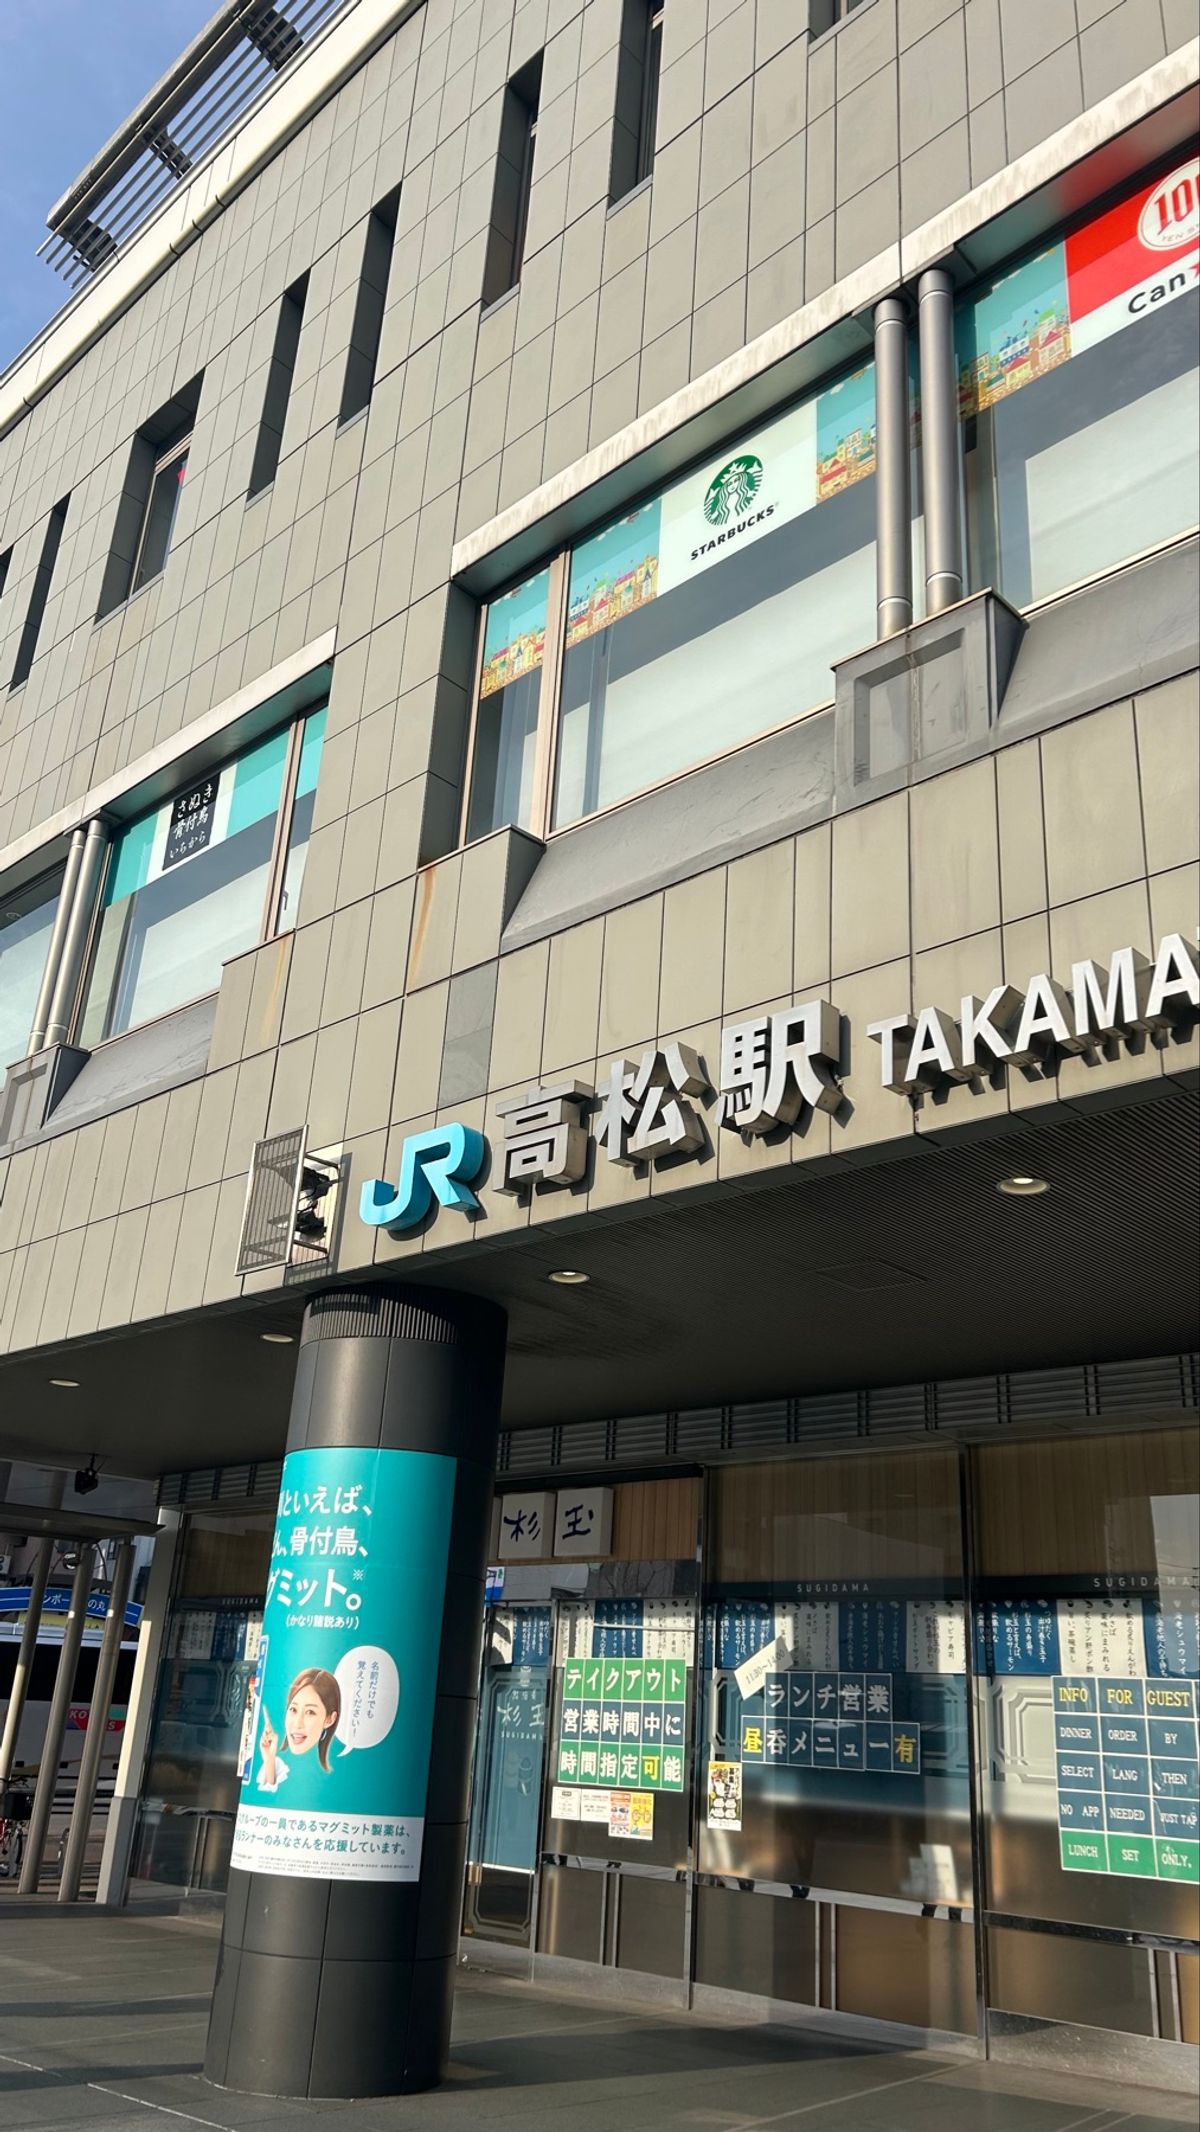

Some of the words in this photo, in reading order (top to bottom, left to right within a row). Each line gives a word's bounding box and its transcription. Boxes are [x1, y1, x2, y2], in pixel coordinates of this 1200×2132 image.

[1128, 271, 1186, 314] Can
[690, 505, 775, 560] STARBUCKS
[177, 783, 213, 818] さぬき
[359, 1122, 482, 1231] JR
[495, 1000, 838, 1194] 高松駅
[867, 926, 1199, 1088] TAKAMA
[503, 1505, 594, 1541] 杉玉
[797, 1583, 869, 1592] SUGIDAMA
[566, 1667, 681, 1692] テイクアウト
[767, 1684, 890, 1713] ランチ営業
[1058, 1687, 1088, 1702] INFO
[1107, 1689, 1133, 1704] FOR
[1147, 1691, 1191, 1706] GUEST
[562, 1708, 682, 1737] 営業時間中に
[1060, 1727, 1092, 1739] DINNER
[1108, 1729, 1138, 1742] ORDER
[1164, 1733, 1177, 1744] BY
[743, 1727, 917, 1764] 昼呑メニュー有
[560, 1750, 682, 1782] 時間指定可能
[1061, 1765, 1094, 1778] SELECT
[1112, 1769, 1138, 1781] LANG
[1161, 1772, 1187, 1784] THEN
[1060, 1804, 1073, 1815] NO
[1082, 1806, 1099, 1817] APP
[1109, 1807, 1145, 1821] NEEDED
[1068, 1844, 1099, 1858] LUNCH
[1121, 1849, 1140, 1862] SET
